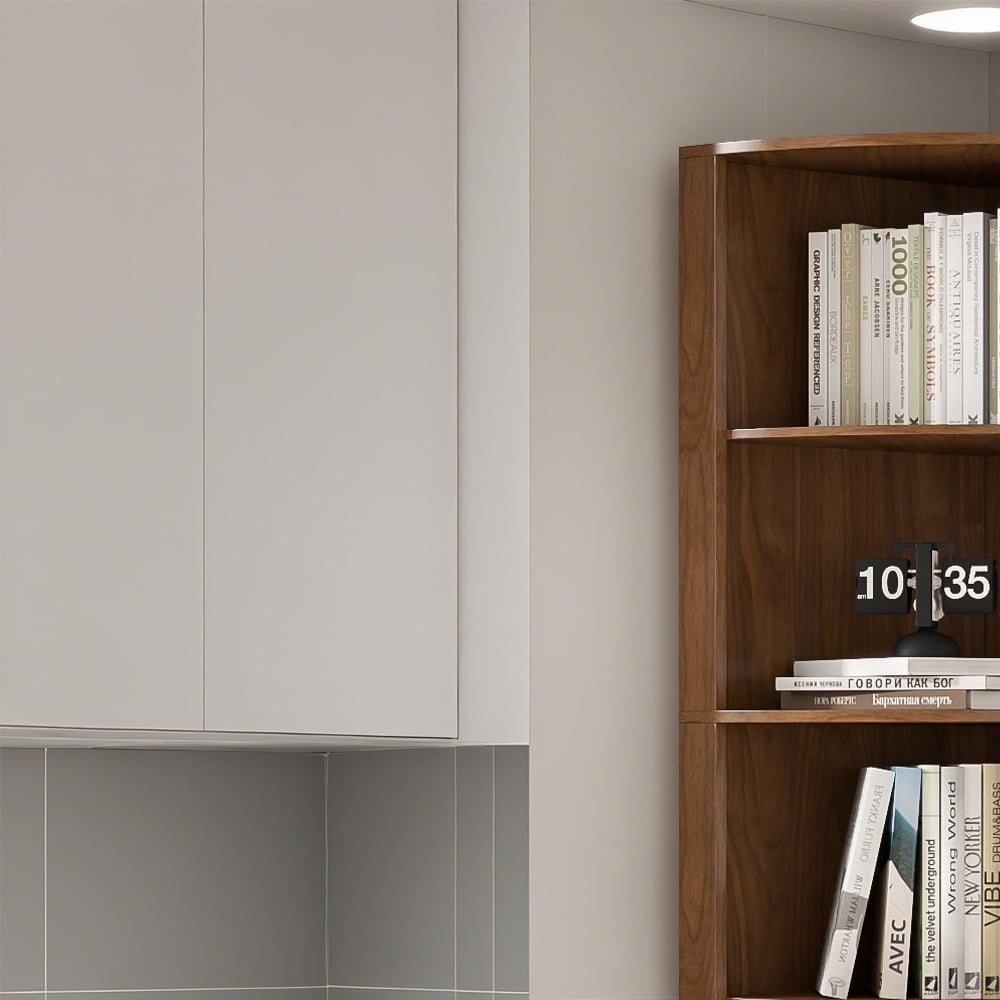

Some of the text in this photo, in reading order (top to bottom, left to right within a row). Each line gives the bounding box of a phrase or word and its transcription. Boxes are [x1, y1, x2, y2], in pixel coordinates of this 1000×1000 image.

[813, 249, 821, 293] GRAPHIC
[891, 236, 908, 296] 1000
[926, 265, 936, 308] BOOK
[813, 295, 821, 330] DESIGN
[829, 311, 837, 364] BORDEAUX
[950, 269, 961, 375] ANTIQUAIRES
[813, 333, 821, 395] REFERENCED
[844, 343, 852, 384] Top
[926, 324, 936, 402] SYMBOLS
[859, 565, 991, 600] 10 35
[848, 677, 955, 689] ГОВОРИ КАК БОГ
[872, 693, 953, 709] Бархатная смерть
[947, 781, 958, 914] Wrong World
[963, 816, 981, 915] NEW YORKER
[925, 839, 938, 963] the velvet underground
[984, 871, 1000, 927] VIBE
[888, 919, 906, 975] AVEC
